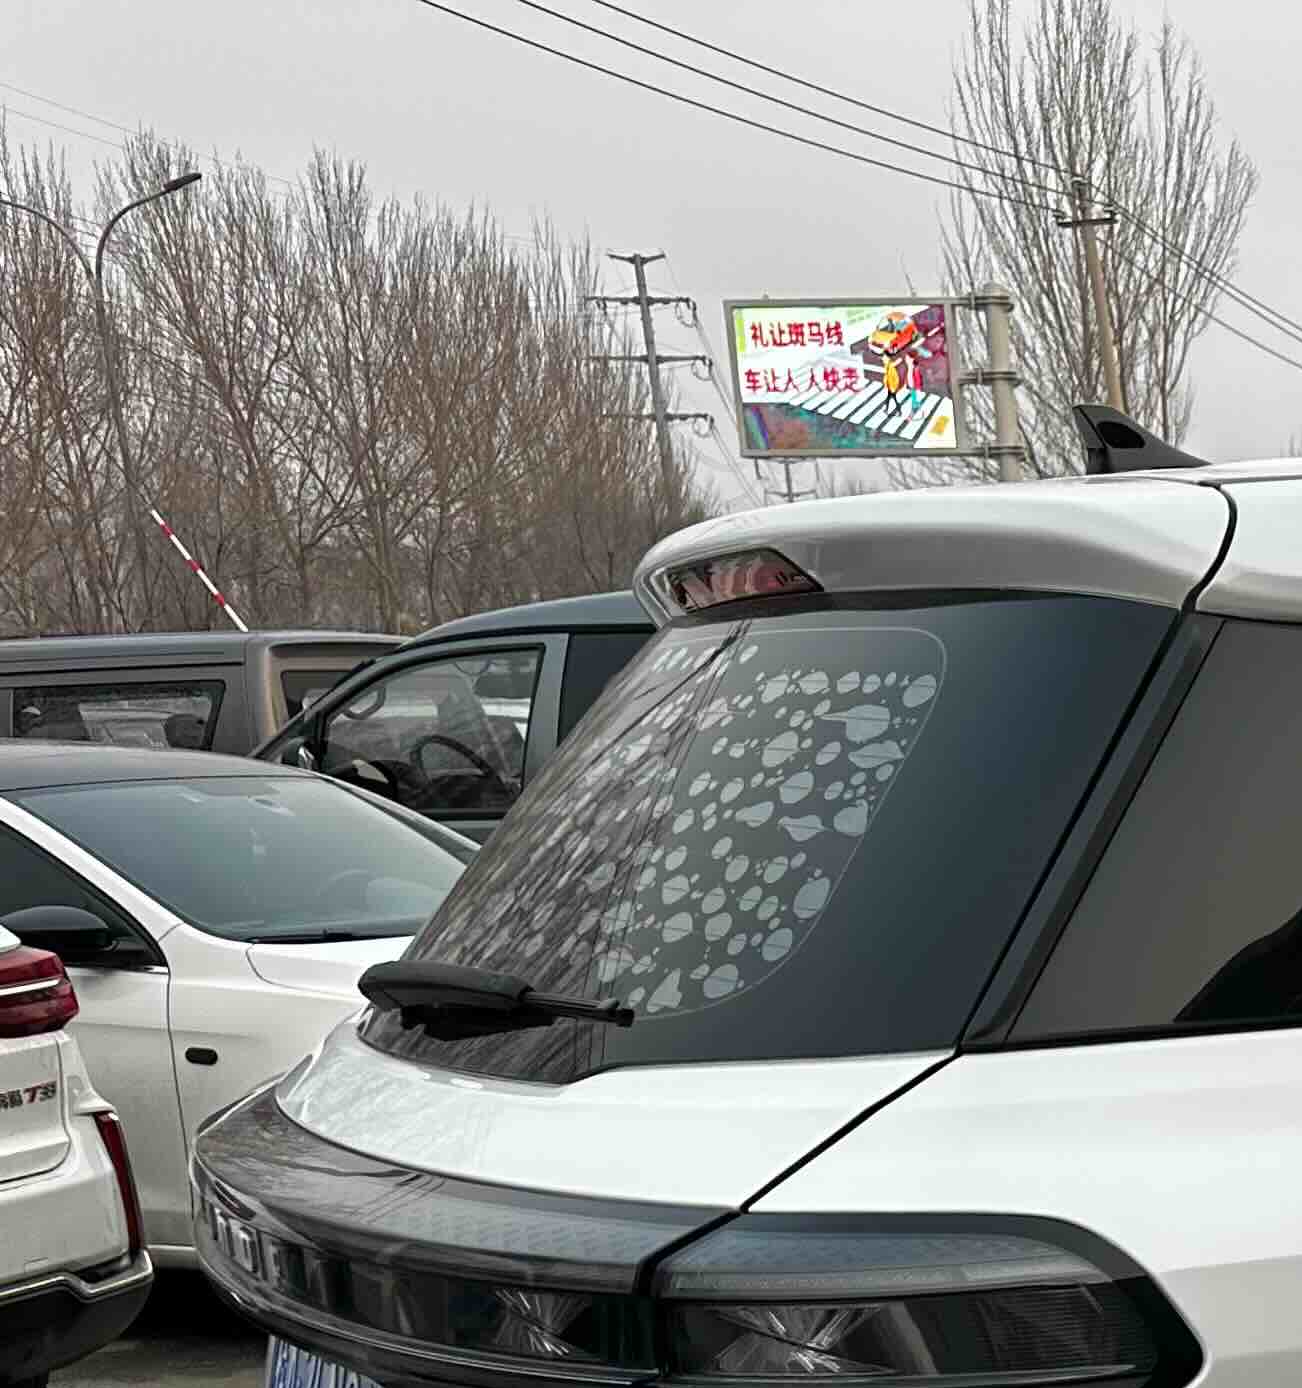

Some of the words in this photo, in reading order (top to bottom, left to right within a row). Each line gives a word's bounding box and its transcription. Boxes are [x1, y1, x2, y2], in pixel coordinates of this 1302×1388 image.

[751, 320, 845, 347] 礼让斑马线
[744, 367, 799, 393] 车让人
[807, 367, 864, 393] 人快走
